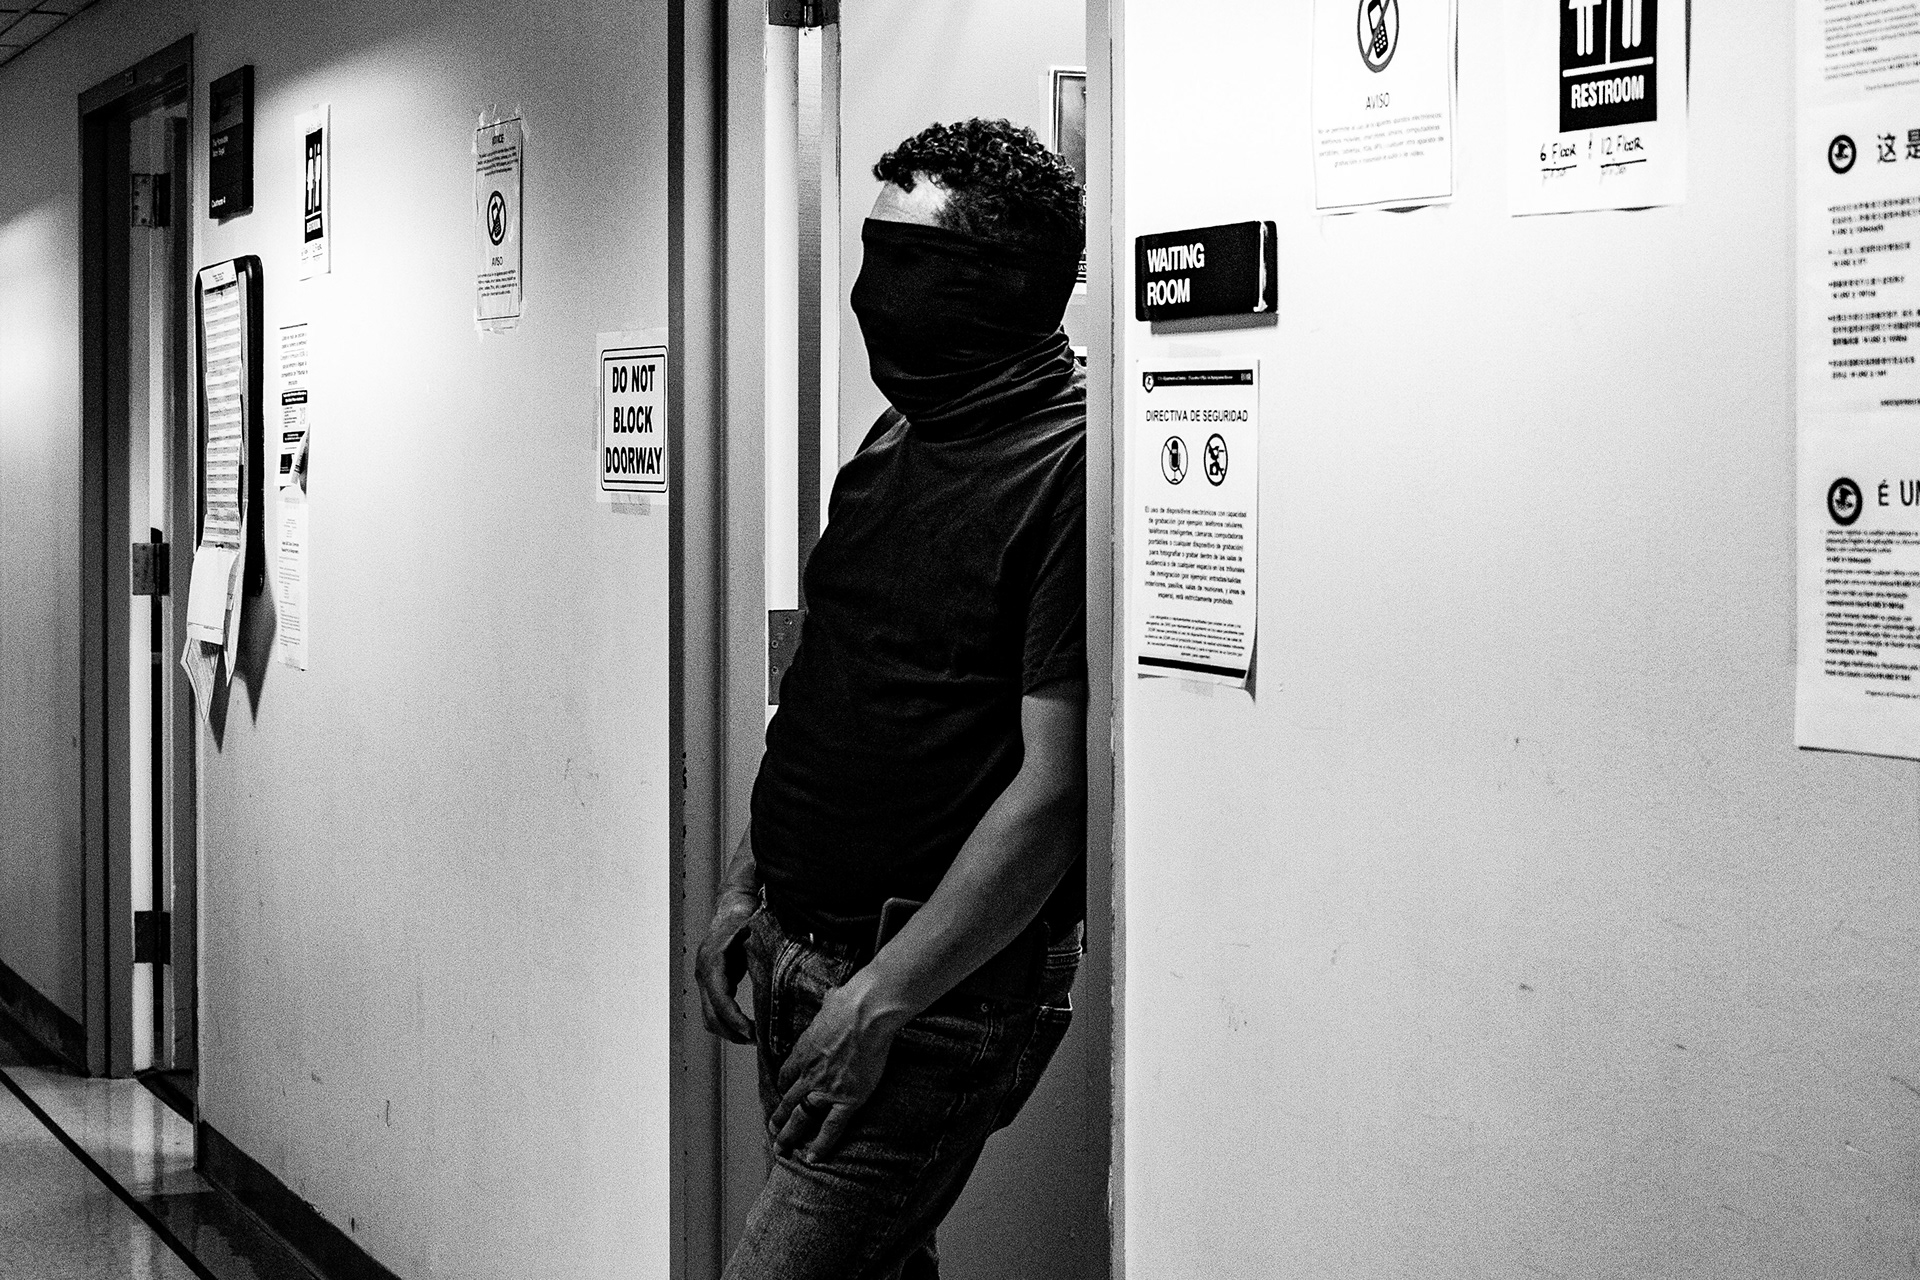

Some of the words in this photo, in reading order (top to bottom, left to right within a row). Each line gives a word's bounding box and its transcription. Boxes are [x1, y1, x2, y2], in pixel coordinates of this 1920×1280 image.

[1365, 92, 1390, 110] AVISO
[1571, 75, 1644, 109] RESTROOM
[1540, 143, 1547, 161] 6
[1601, 136, 1613, 155] 12
[1147, 242, 1205, 273] WAITING
[1147, 277, 1190, 306] ROOM
[612, 366, 628, 393] DO
[631, 364, 656, 393] NOT
[613, 405, 653, 433] BLOCK
[1145, 409, 1188, 422] DIRECTIVA
[1190, 409, 1201, 422] DE
[1202, 409, 1248, 422] SEGURIDAD
[605, 446, 663, 474] DOORWAY
[1878, 479, 1889, 507] É
